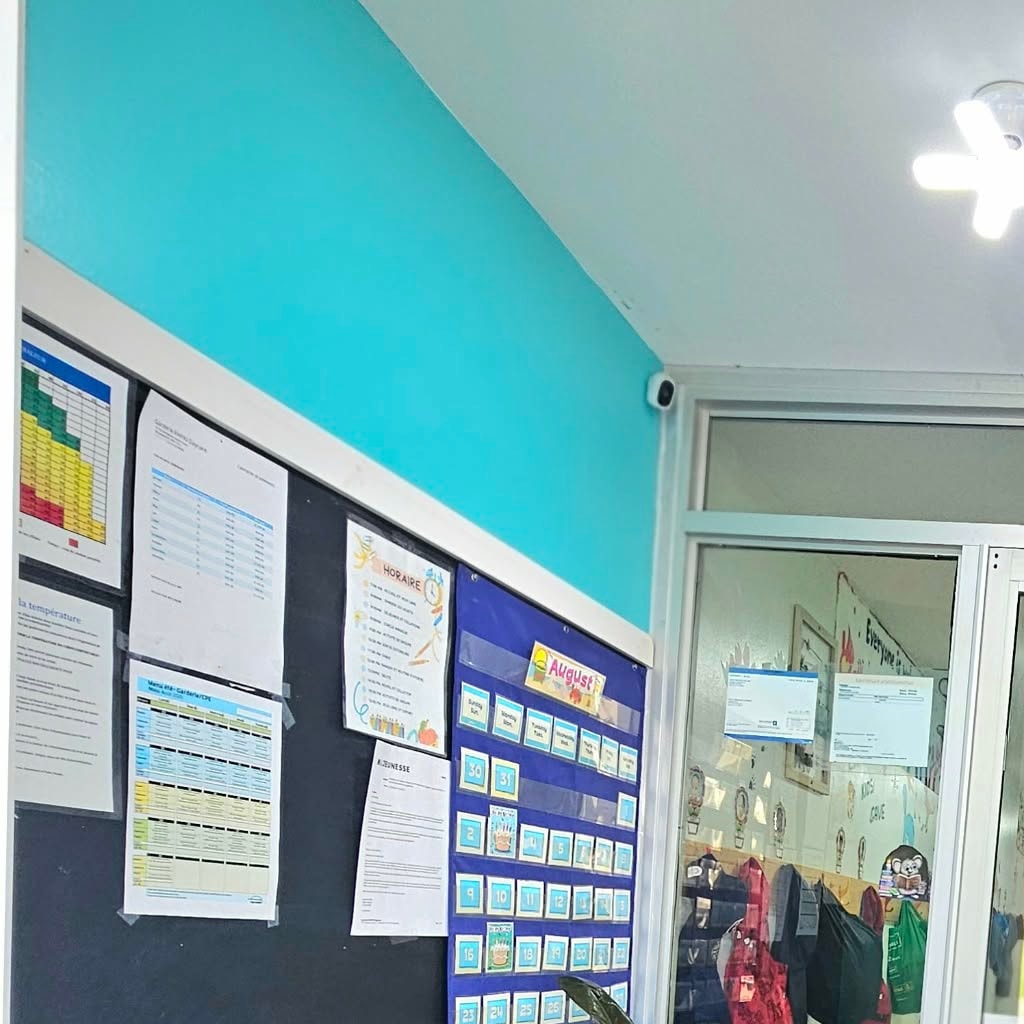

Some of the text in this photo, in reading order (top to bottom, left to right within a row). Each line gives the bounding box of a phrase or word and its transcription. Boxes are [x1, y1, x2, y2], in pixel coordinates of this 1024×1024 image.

[383, 564, 422, 592] HORAIRE
[29, 602, 82, 625] température
[549, 659, 593, 691] August
[468, 762, 482, 778] 30
[500, 772, 511, 787] 31
[466, 825, 474, 841] 2
[467, 887, 474, 901] 9
[496, 890, 507, 903] 10
[526, 892, 534, 905] 11
[554, 895, 564, 908] 12
[464, 947, 474, 961] 16
[523, 947, 533, 960] 18
[463, 1009, 475, 1023] 23
[490, 1006, 503, 1019] 24
[520, 1004, 532, 1017] 25
